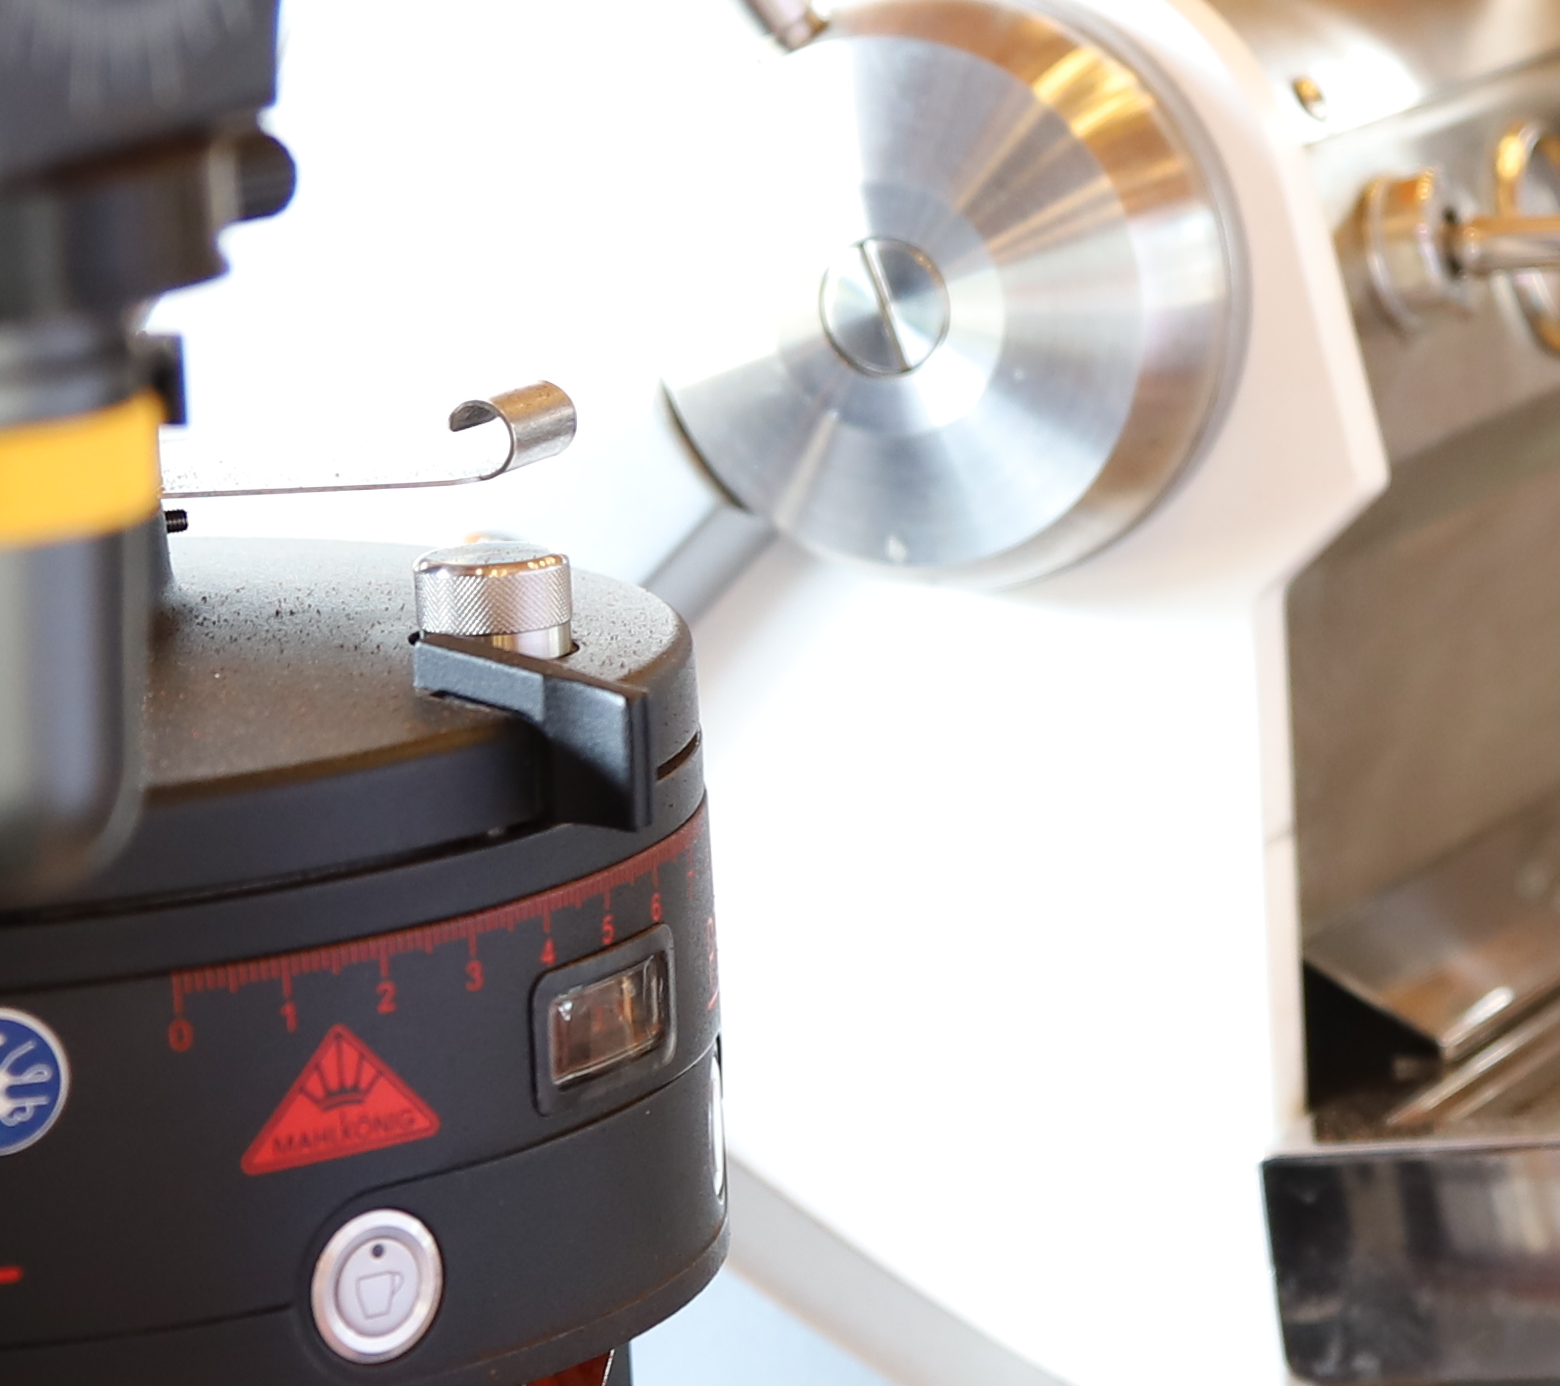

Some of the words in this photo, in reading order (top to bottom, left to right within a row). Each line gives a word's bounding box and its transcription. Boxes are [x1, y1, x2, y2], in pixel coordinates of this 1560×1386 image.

[168, 1018, 194, 1052] 0
[279, 1001, 297, 1033] 1
[376, 980, 398, 1014] 2
[465, 960, 484, 992] 3
[541, 938, 555, 967] 4
[602, 915, 615, 945] 5
[650, 892, 662, 922] 6
